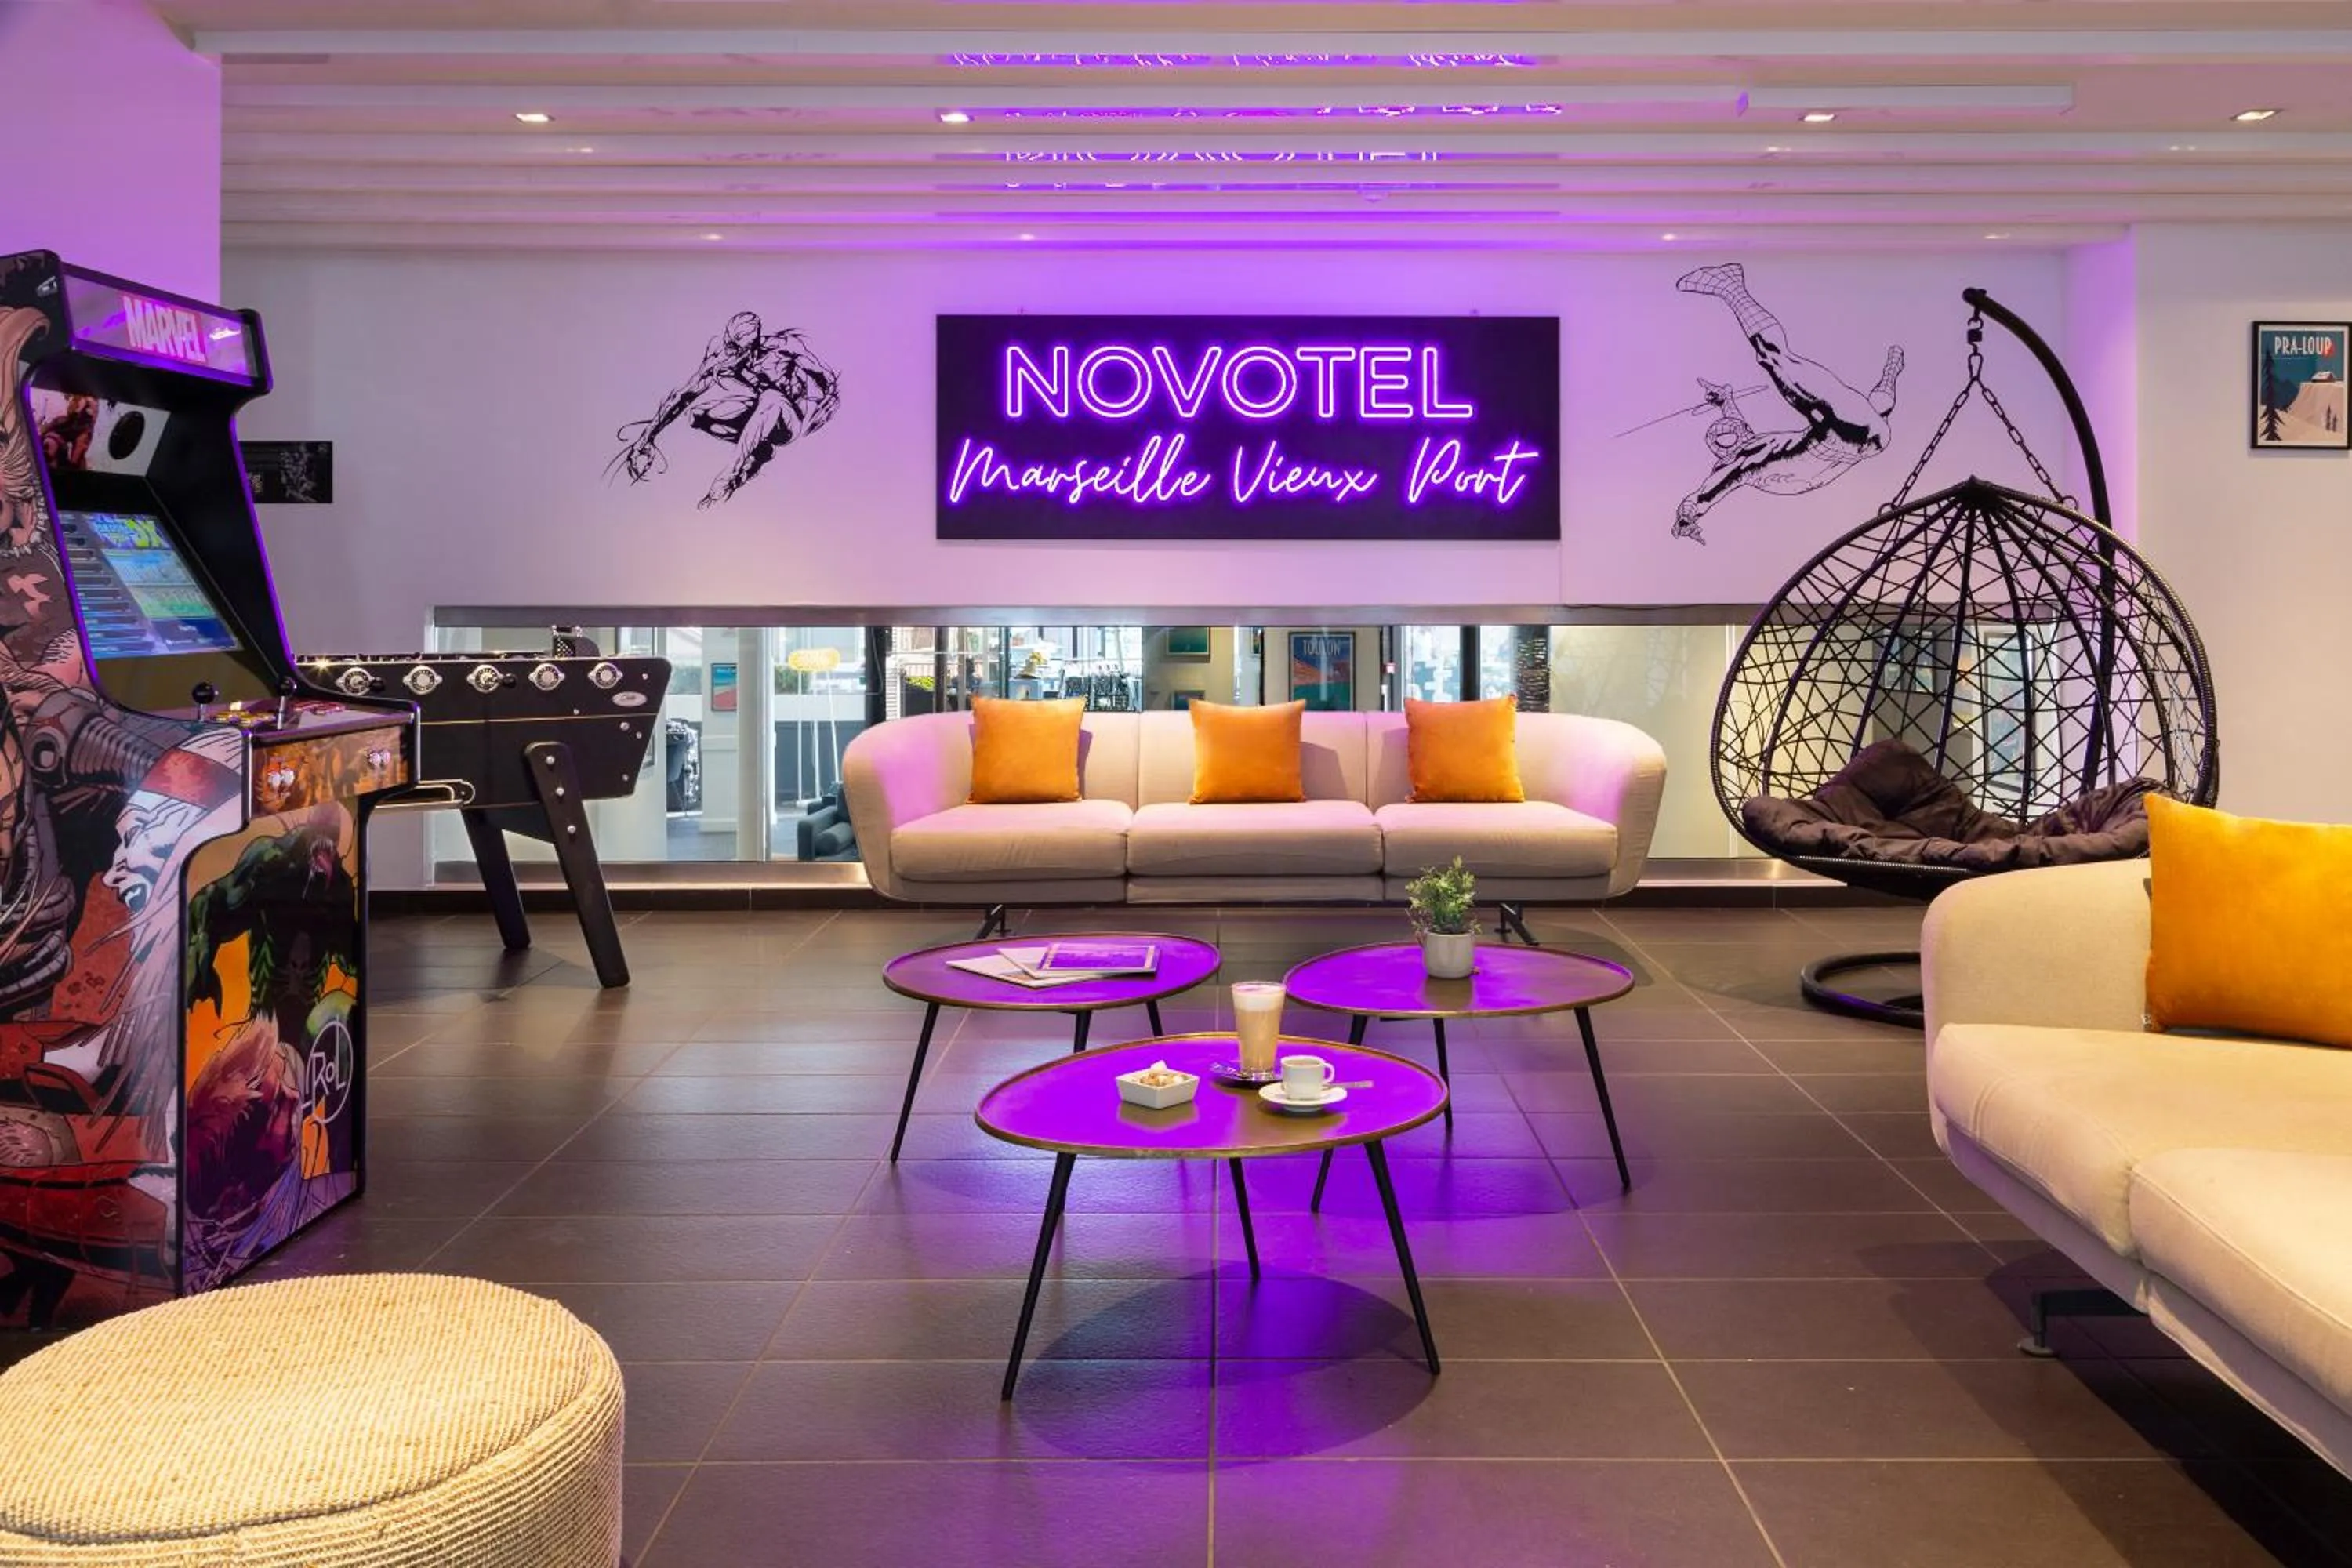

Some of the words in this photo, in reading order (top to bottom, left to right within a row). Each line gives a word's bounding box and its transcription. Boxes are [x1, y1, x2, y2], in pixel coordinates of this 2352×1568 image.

[124, 296, 205, 362] MARVEL
[2274, 336, 2332, 355] PRA-LOUP
[1007, 346, 1472, 417] NOVOTEL
[949, 433, 1210, 503] Marseille
[1234, 441, 1377, 502] Vieux
[1408, 437, 1538, 503] Port
